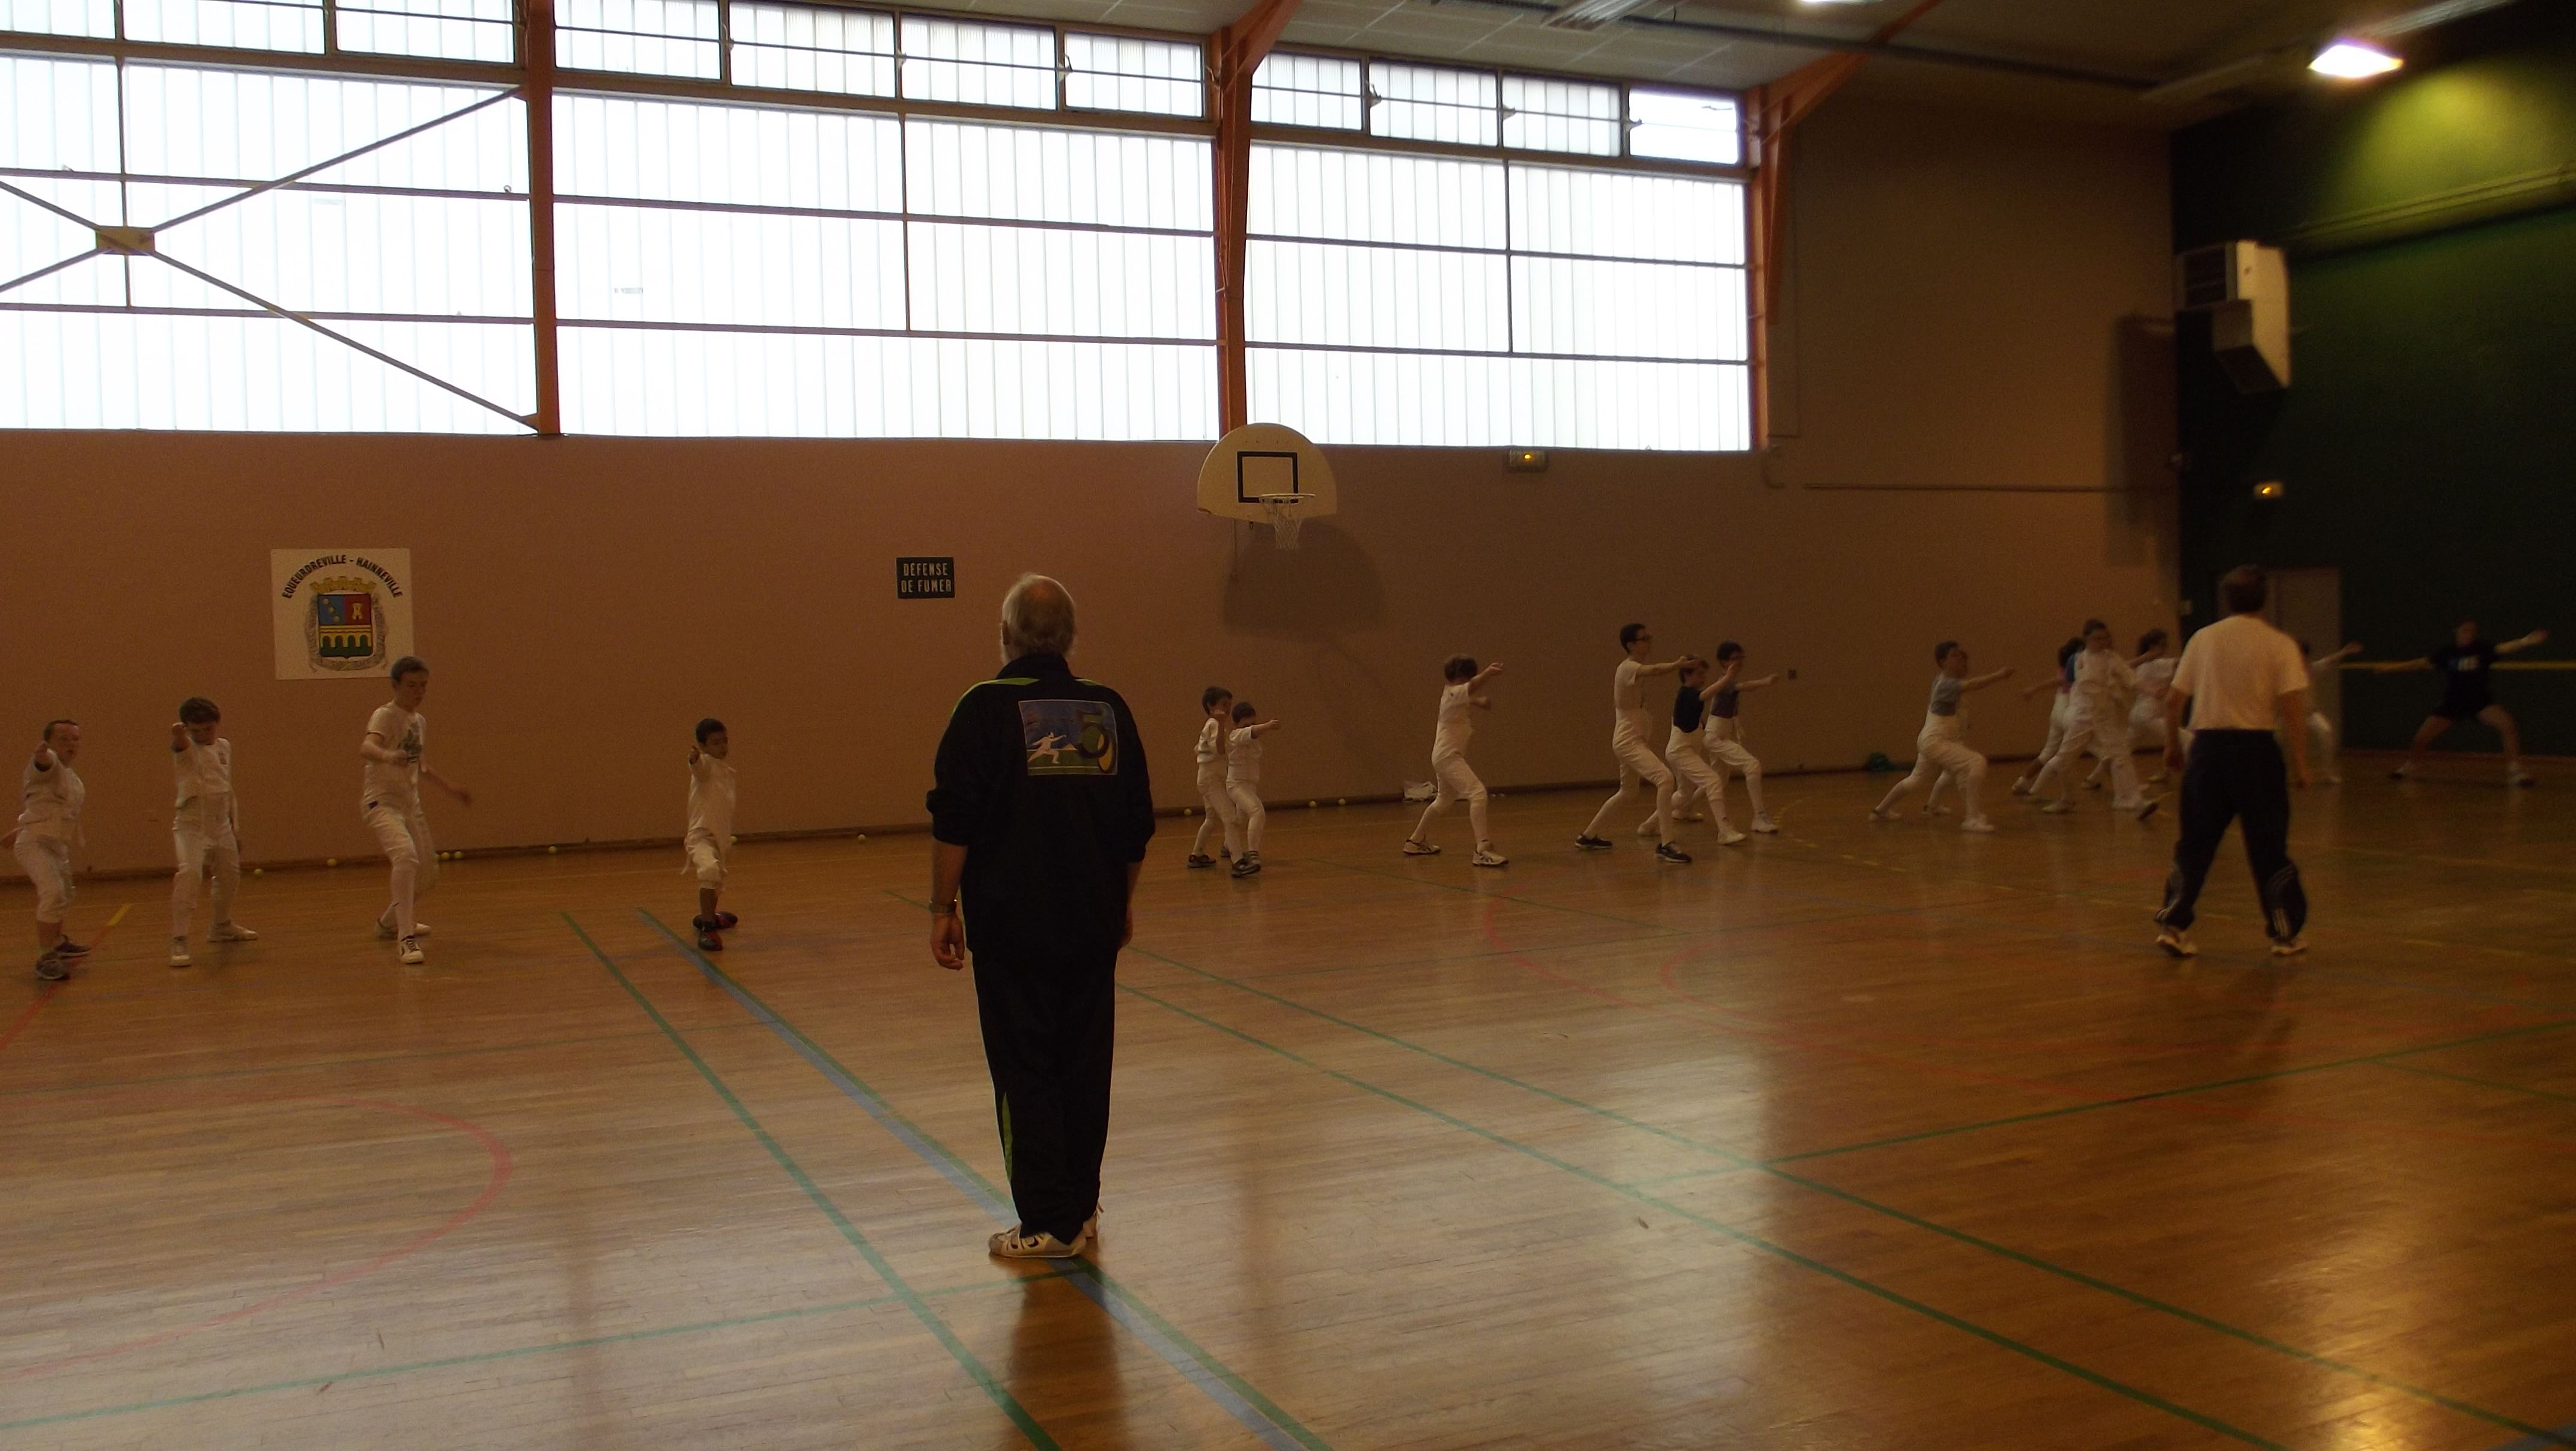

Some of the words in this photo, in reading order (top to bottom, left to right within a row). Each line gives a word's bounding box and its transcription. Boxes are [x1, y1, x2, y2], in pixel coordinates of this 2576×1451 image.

[282, 554, 346, 598] EQUEURDREVILLE
[356, 557, 402, 598] HAINNEVILLE
[902, 580, 913, 593] DE
[918, 579, 952, 592] FUMER
